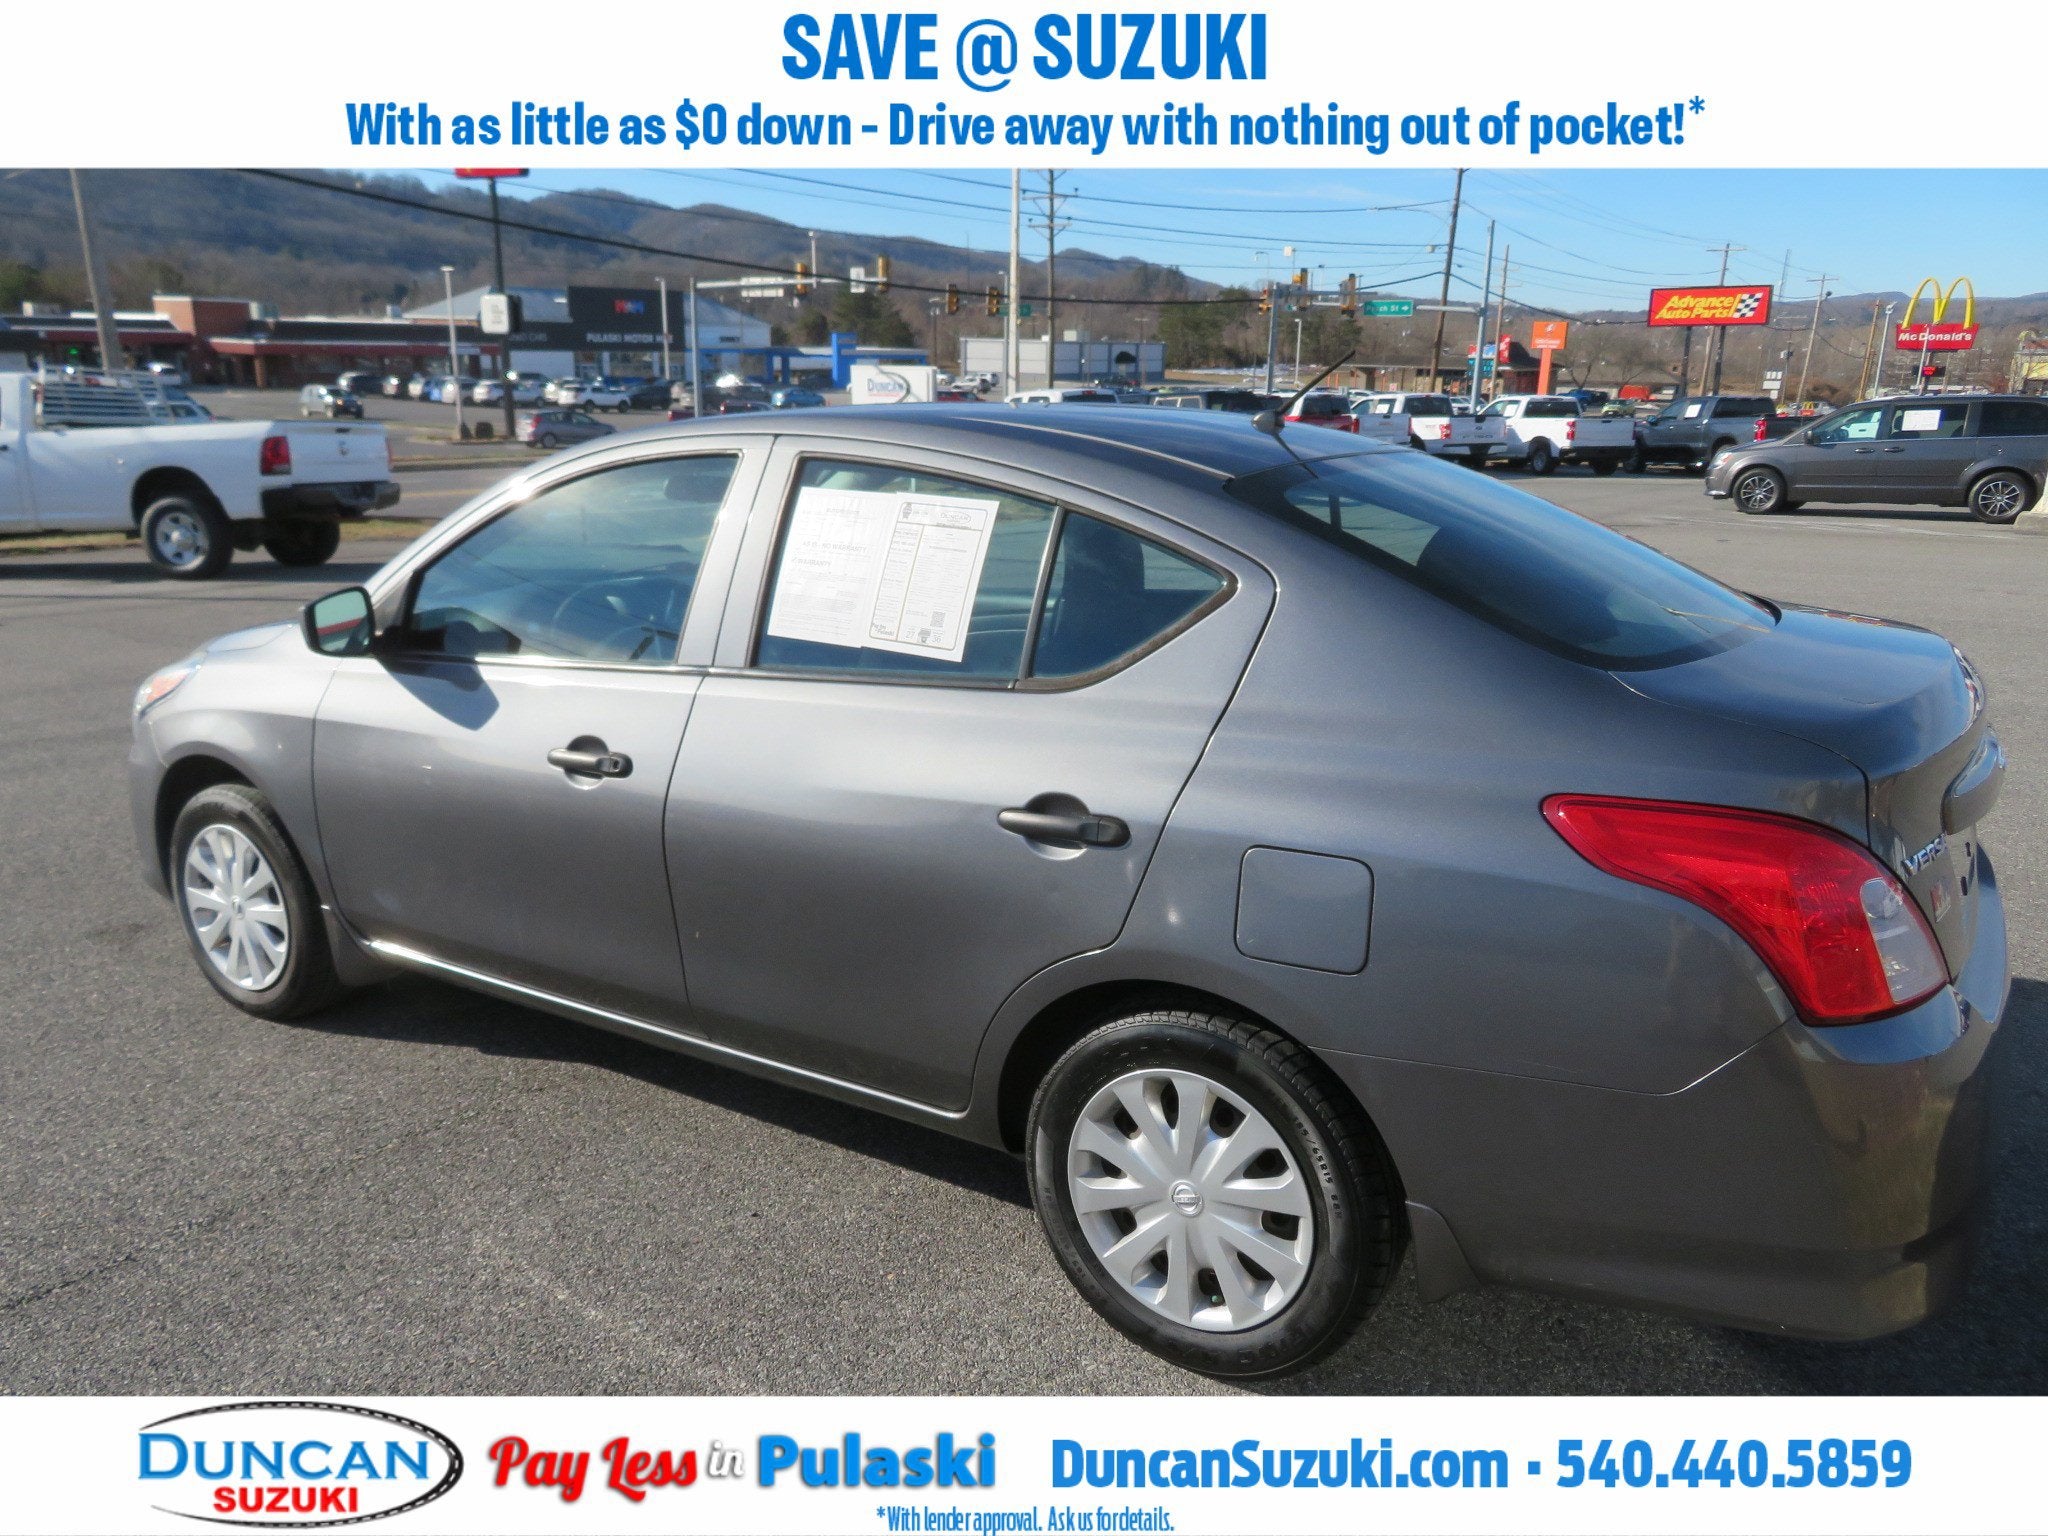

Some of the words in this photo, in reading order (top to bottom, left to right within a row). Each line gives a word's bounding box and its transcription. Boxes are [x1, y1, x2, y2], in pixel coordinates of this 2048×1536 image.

[1664, 294, 1733, 308] Advance
[1654, 308, 1689, 320] Auto
[1690, 306, 1731, 320] Parts
[1898, 331, 1973, 342] McDonald's
